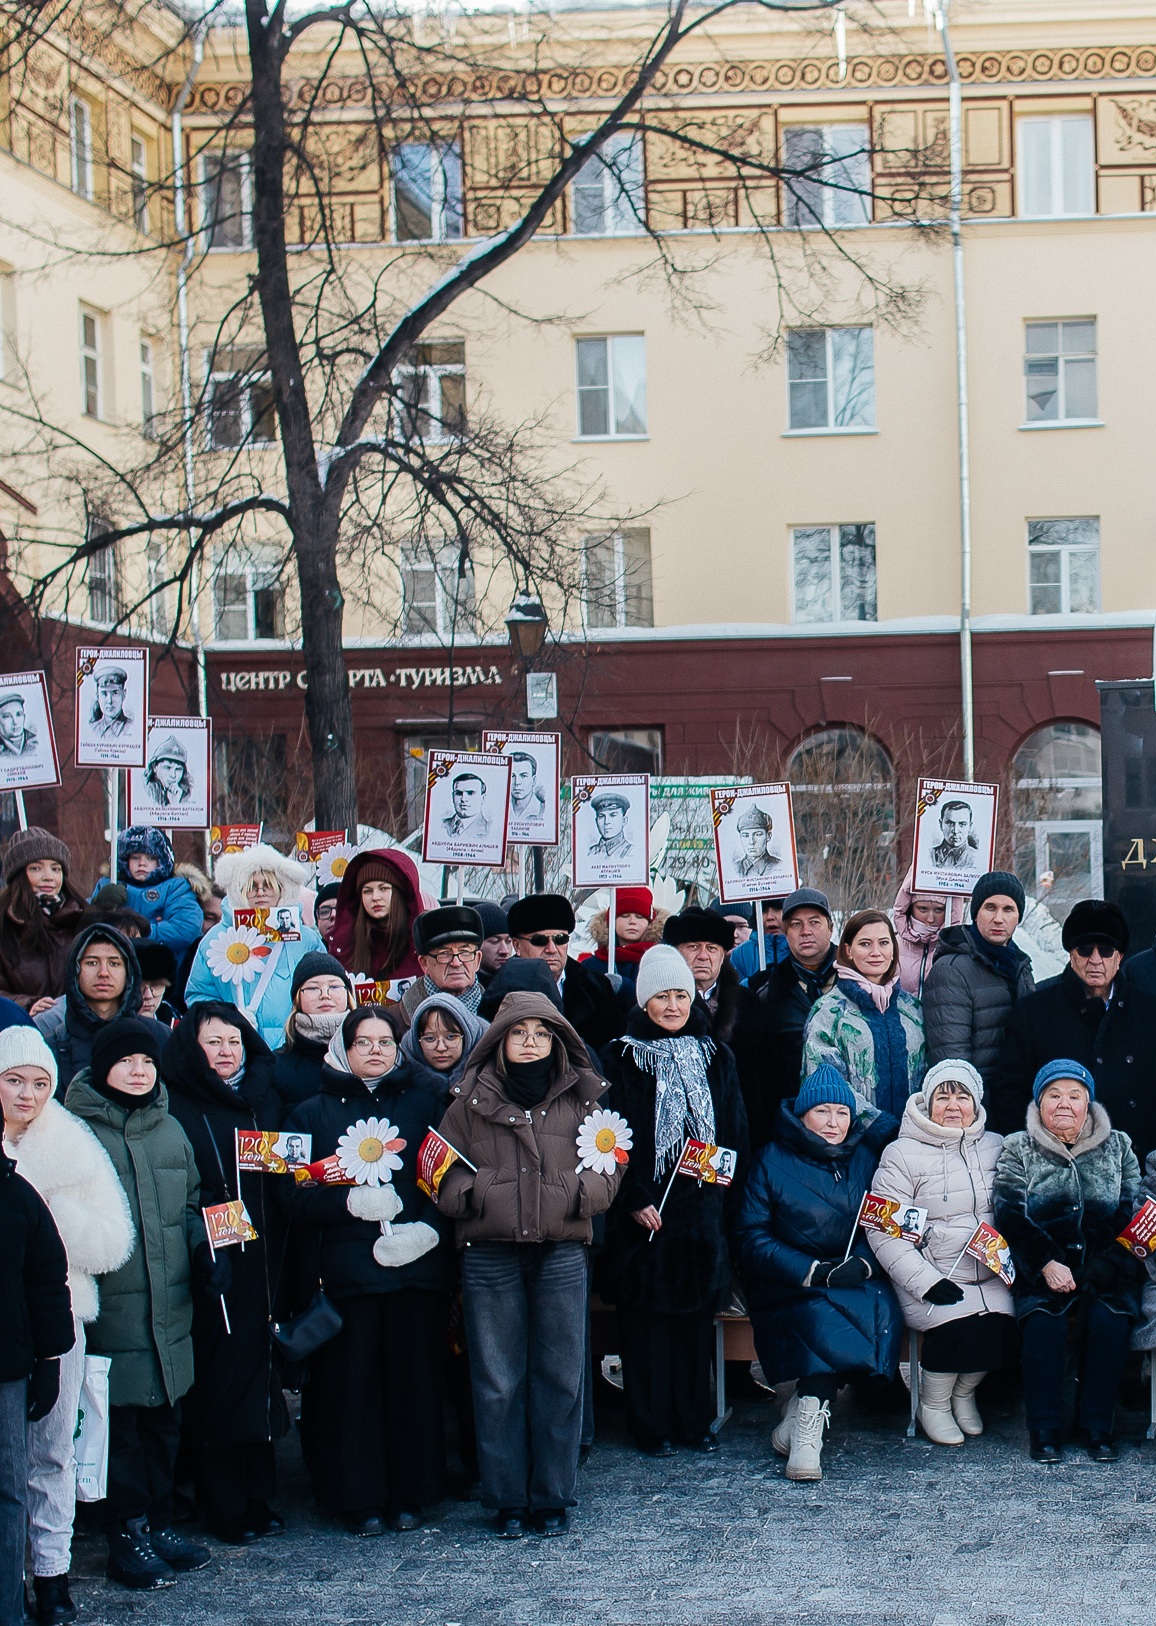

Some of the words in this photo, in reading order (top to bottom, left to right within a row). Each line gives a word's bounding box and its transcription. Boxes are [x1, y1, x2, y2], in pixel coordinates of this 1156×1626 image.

[80, 649, 143, 659] ГЕРОИ-ДЖАЛИЛОВЦЫ
[220, 671, 291, 693] ЦЕНТР
[297, 668, 387, 689] СРТА
[396, 665, 502, 690] ТУРИЗМА
[487, 733, 556, 743] ГЕРОИ-ДЖАЛИЛОВЦЫ
[434, 753, 508, 765] ГЕРОИ-ДЖАЛИЛОВЦЫ
[576, 776, 645, 787] ГЕРОИ-ДЖАЛИЛОВЦЫ
[923, 781, 994, 794] ГЕРОИ-ДЖАЛИЛОВЦЫ
[715, 785, 786, 799] ГЕРОИ-ДЖАЛИЛОВЦЫ
[358, 987, 383, 1004] 120
[239, 1136, 268, 1156] 120
[684, 1145, 708, 1164] 120
[863, 1199, 890, 1219] 120
[208, 1210, 241, 1232] 120
[975, 1228, 1001, 1250] 120
